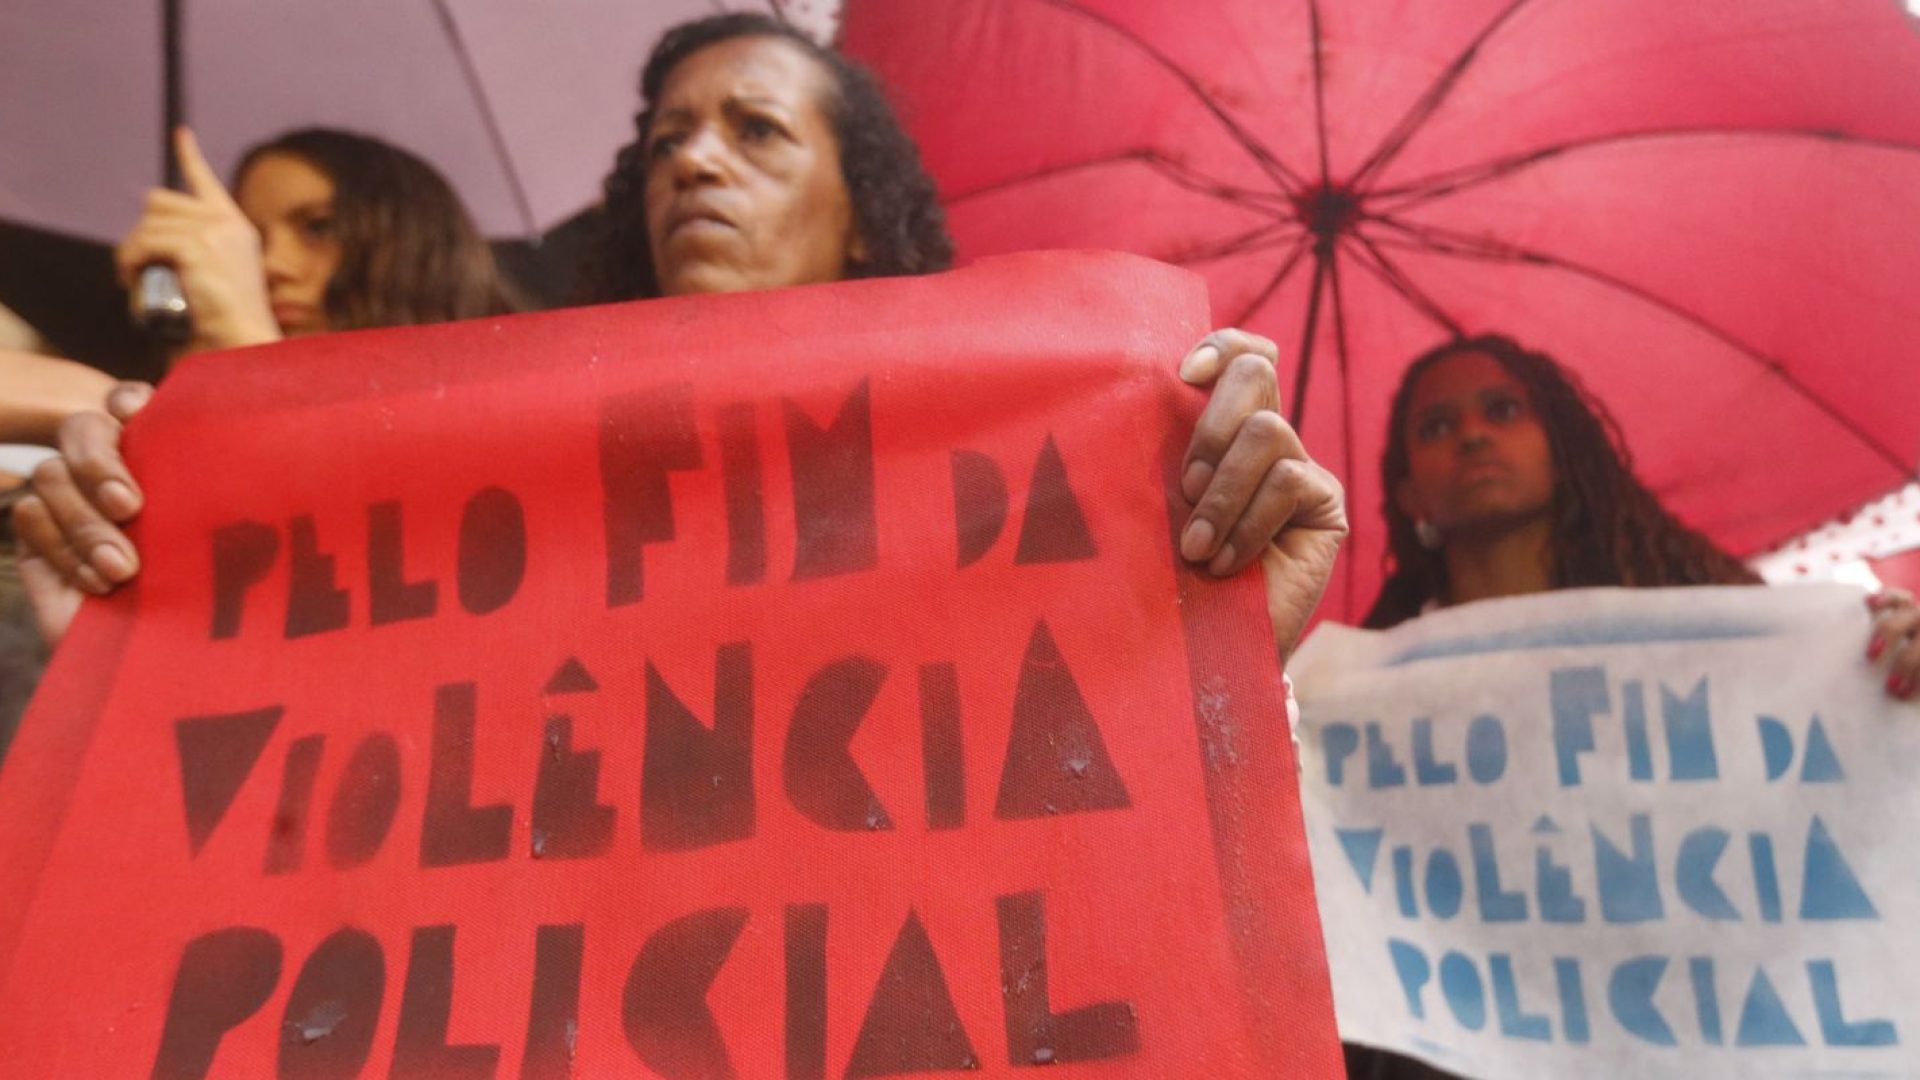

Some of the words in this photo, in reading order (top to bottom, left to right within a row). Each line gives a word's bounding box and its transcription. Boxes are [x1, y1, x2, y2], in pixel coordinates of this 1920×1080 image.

[211, 486, 527, 640] PELO
[601, 376, 879, 609] FIM
[951, 431, 1099, 570] DA
[174, 616, 1132, 876] VIOLÊNCIA
[1321, 713, 1508, 789] PELO
[1550, 665, 1719, 786] FIM
[1756, 712, 1846, 783] DA
[1334, 813, 1880, 924] VIOLÊNCIA
[150, 890, 1142, 1080] POLICIAL
[1388, 937, 1900, 1047] POLICIAL
